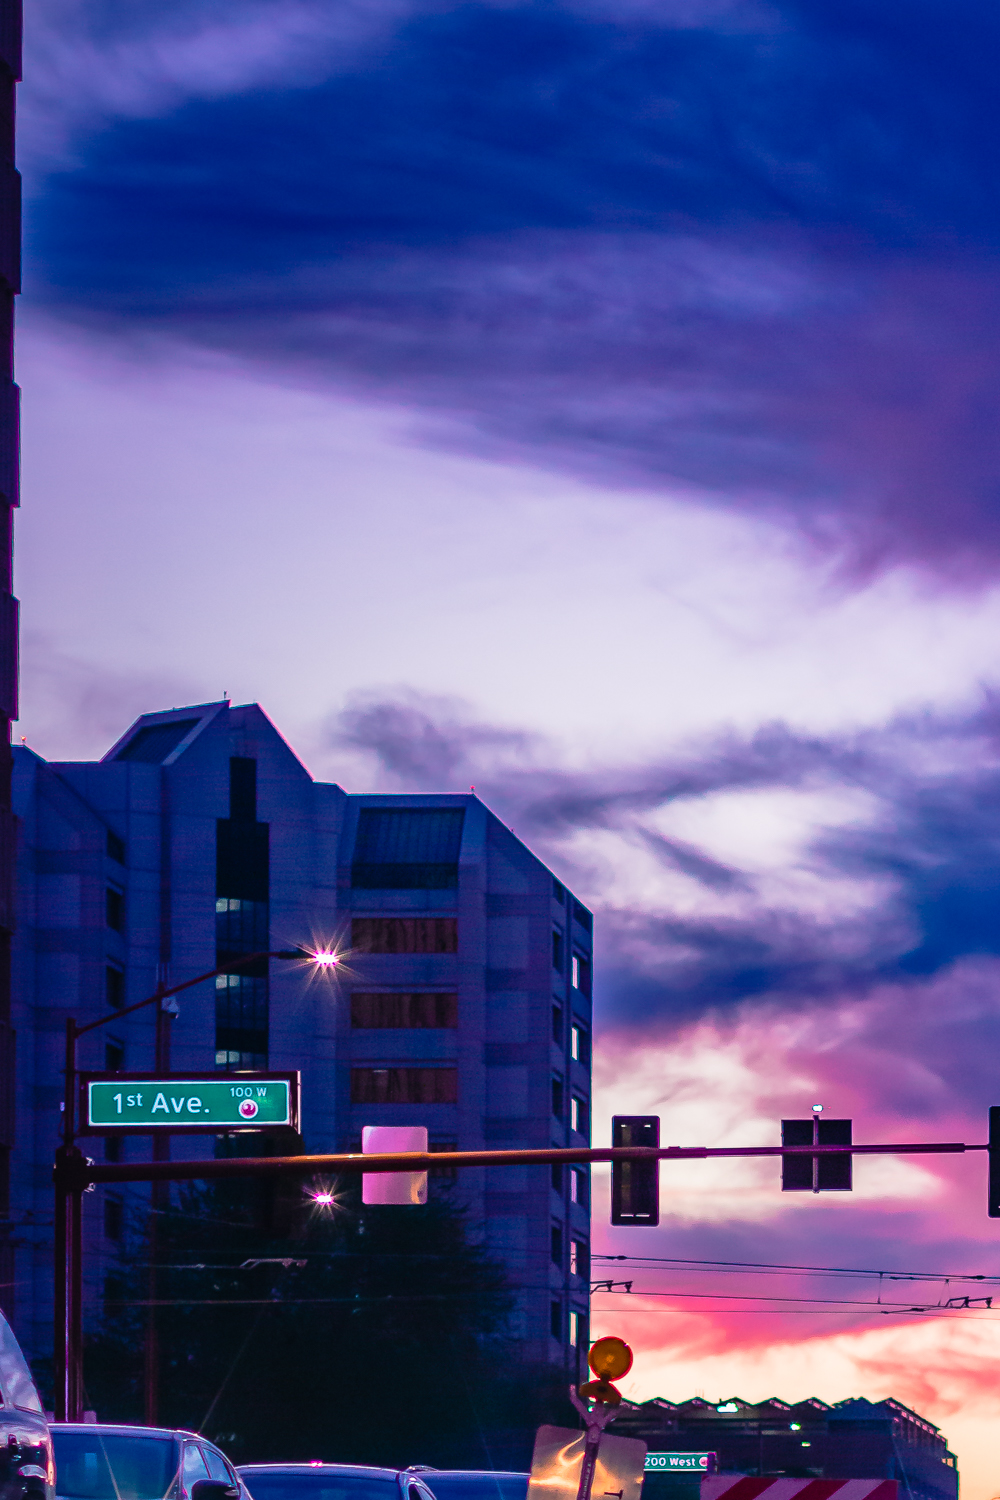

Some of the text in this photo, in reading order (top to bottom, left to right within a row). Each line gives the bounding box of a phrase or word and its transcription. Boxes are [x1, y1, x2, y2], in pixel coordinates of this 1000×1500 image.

[229, 1086, 267, 1098] 100 W
[112, 1092, 211, 1115] 1st Ave.
[644, 1457, 697, 1468] 200 West
